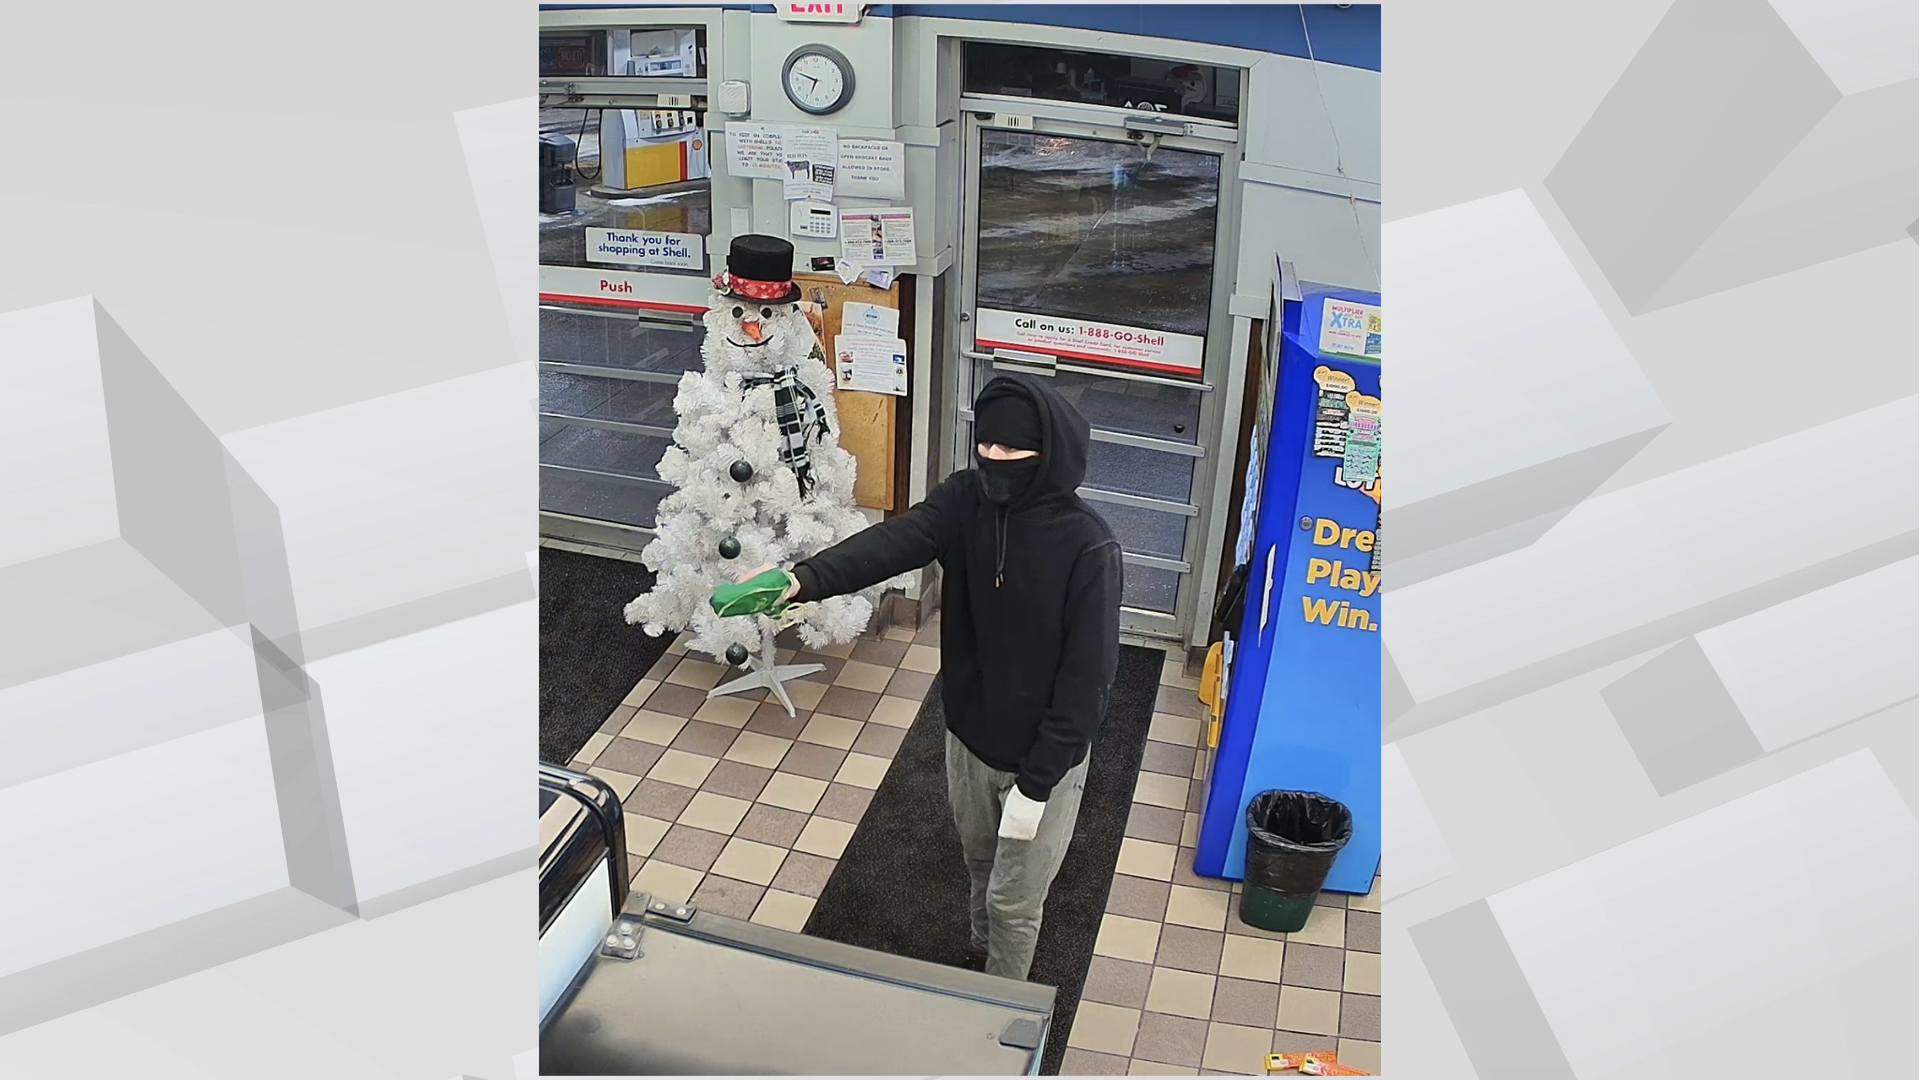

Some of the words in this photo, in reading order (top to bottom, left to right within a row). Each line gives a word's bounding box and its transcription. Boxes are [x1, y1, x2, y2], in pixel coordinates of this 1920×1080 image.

[606, 232, 638, 243] Thank
[642, 236, 662, 246] you
[666, 235, 681, 246] for
[598, 243, 645, 257] shopping
[648, 248, 659, 256] at
[663, 247, 691, 258] Shell.
[600, 280, 633, 293] Push
[1330, 311, 1362, 329] XTRA
[1015, 318, 1036, 329] Call
[1040, 323, 1054, 332] on
[1058, 326, 1075, 334] us:
[1078, 326, 1164, 346] 1-888-GO-Shell
[1302, 596, 1378, 631] Win.
